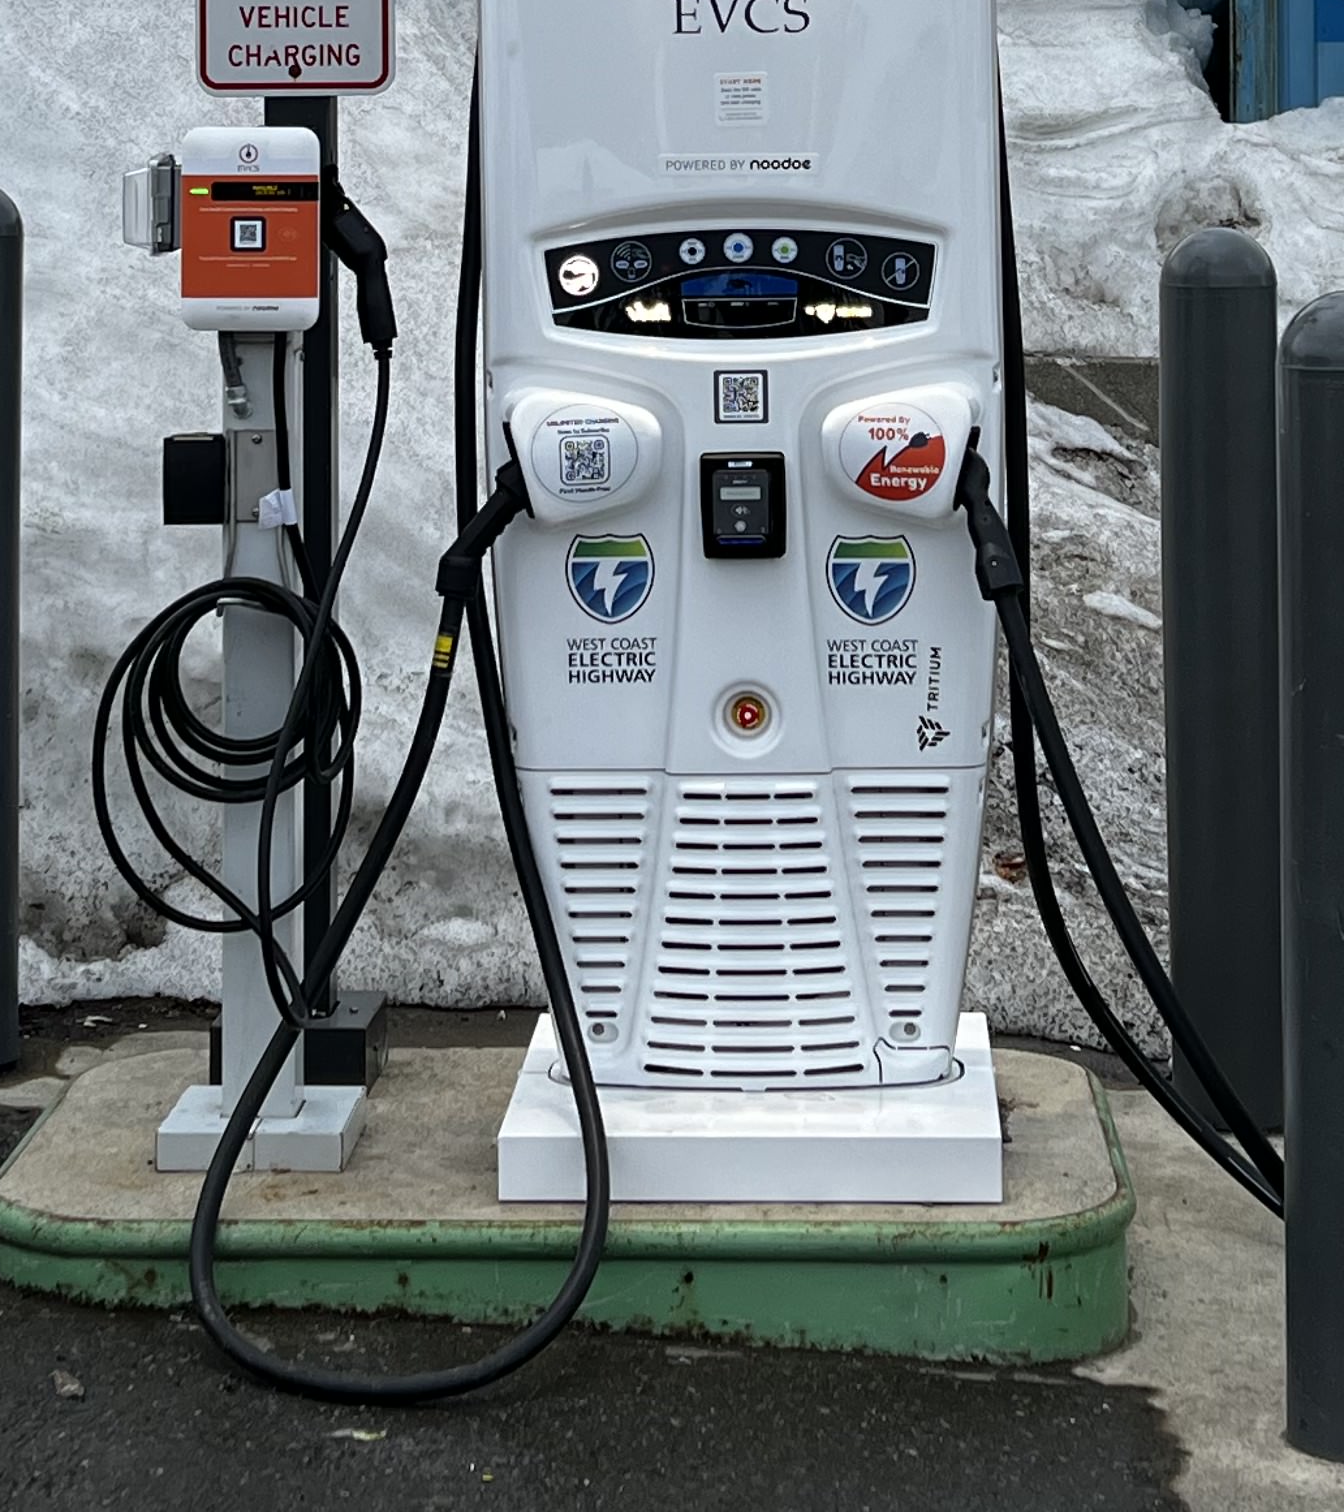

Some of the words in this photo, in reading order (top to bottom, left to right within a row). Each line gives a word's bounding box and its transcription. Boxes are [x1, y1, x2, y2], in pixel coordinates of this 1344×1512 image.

[239, 5, 350, 28] VEHICLE
[228, 43, 361, 67] CHARGING
[665, 159, 726, 171] POWERED
[730, 159, 746, 170] BY
[749, 157, 812, 170] noodoe
[857, 415, 897, 423] Powered
[868, 427, 910, 441] 100%
[890, 465, 940, 474] Renewable
[869, 473, 927, 491] Energy
[566, 637, 606, 651] WEST
[610, 637, 657, 650] COAST
[826, 639, 866, 652] WEST
[871, 639, 918, 652] COAST
[568, 651, 657, 667] ELECTRIC
[827, 654, 917, 669] ELECTRIC
[568, 668, 656, 684] HIGHWAY
[828, 671, 917, 685] HIGHWAY
[926, 646, 942, 712] TRITIUM
